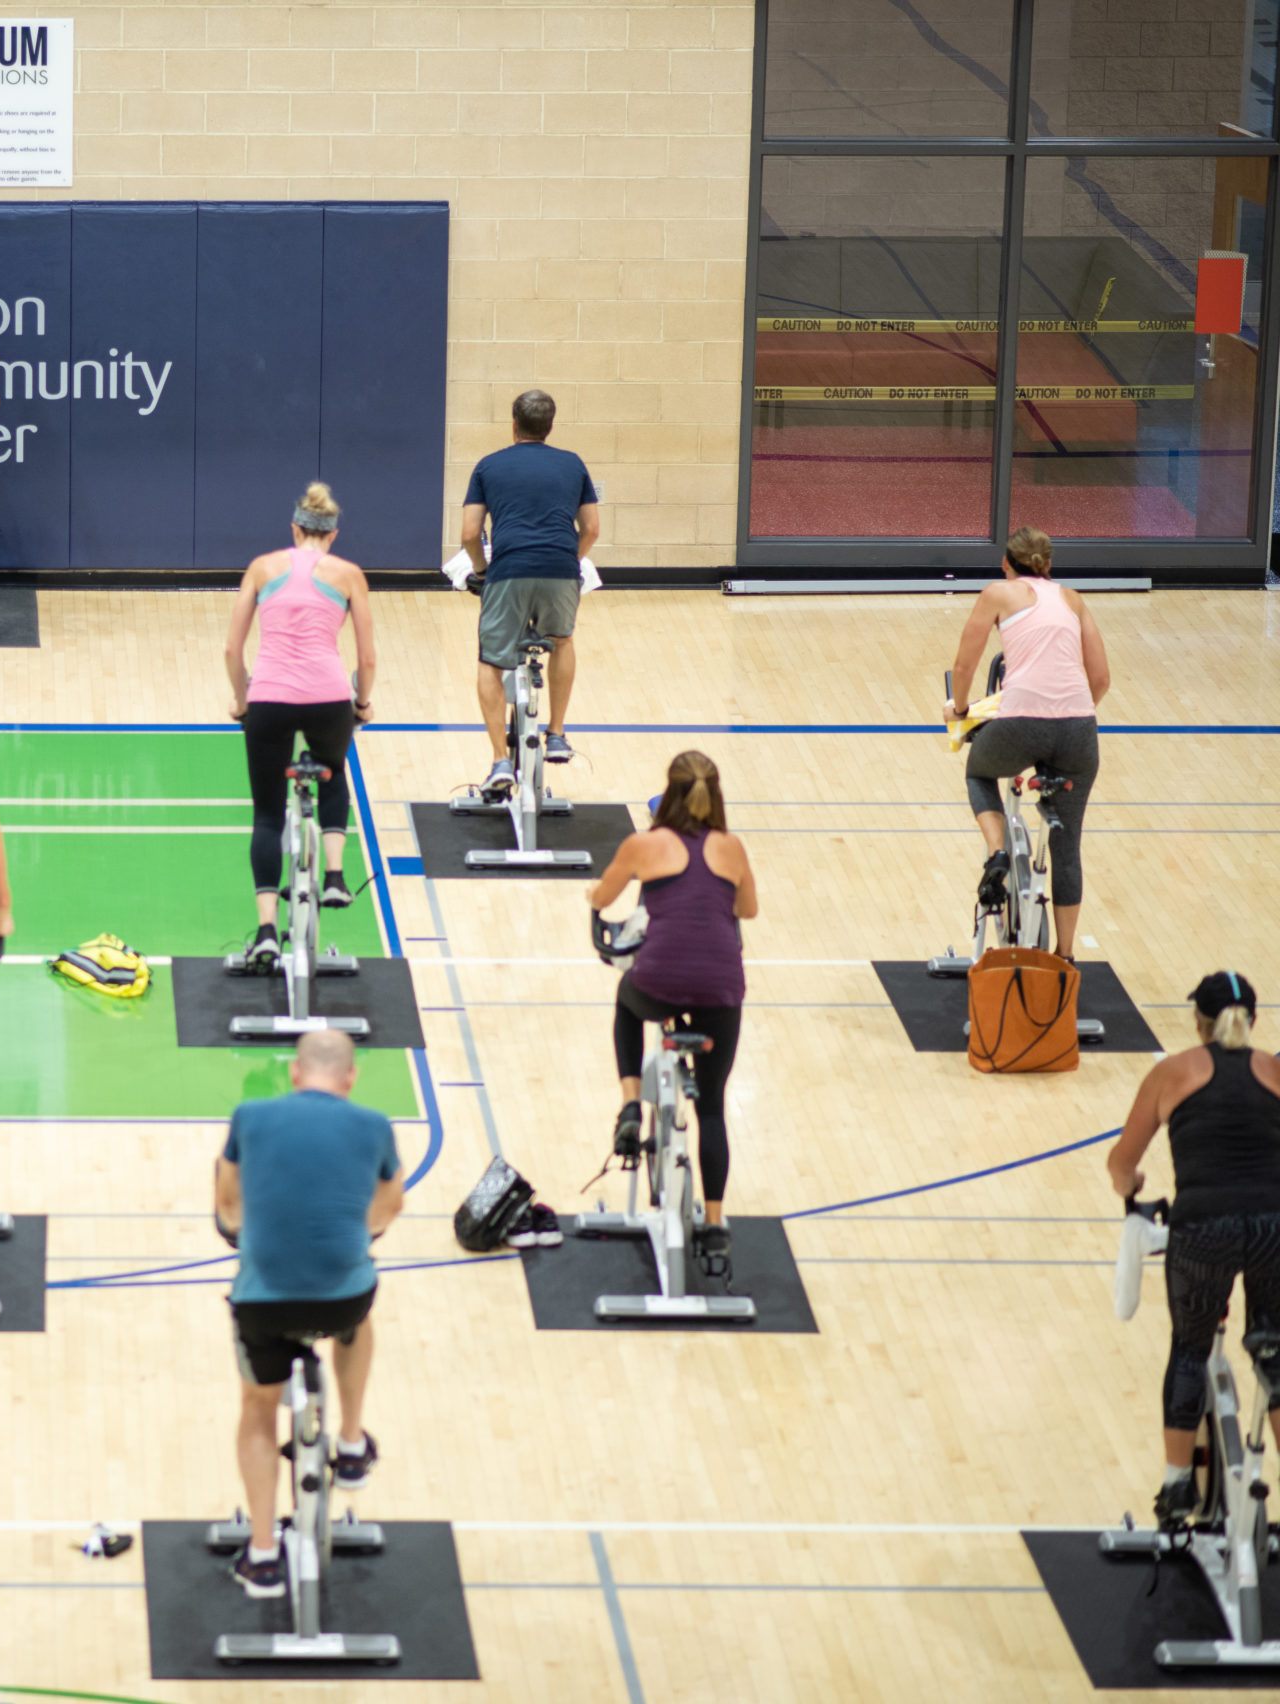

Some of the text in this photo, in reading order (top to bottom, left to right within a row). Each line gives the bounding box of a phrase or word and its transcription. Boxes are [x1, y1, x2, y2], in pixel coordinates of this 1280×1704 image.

[772, 320, 821, 331] CAUTION
[836, 321, 851, 331] DO
[855, 321, 877, 331] NOT
[881, 321, 915, 331] ENTER
[1020, 322, 1034, 331] DO
[1038, 322, 1059, 331] NOT
[1063, 322, 1098, 331] ENTER
[1138, 320, 1187, 330] CAUTION
[754, 389, 783, 399] NTER
[823, 388, 873, 398] CAUTION
[889, 388, 904, 398] DO
[908, 388, 930, 398] NOT
[934, 388, 968, 398] ENTER
[1076, 389, 1091, 398] DO
[1094, 388, 1116, 398] NOT
[1120, 388, 1155, 398] ENTER
